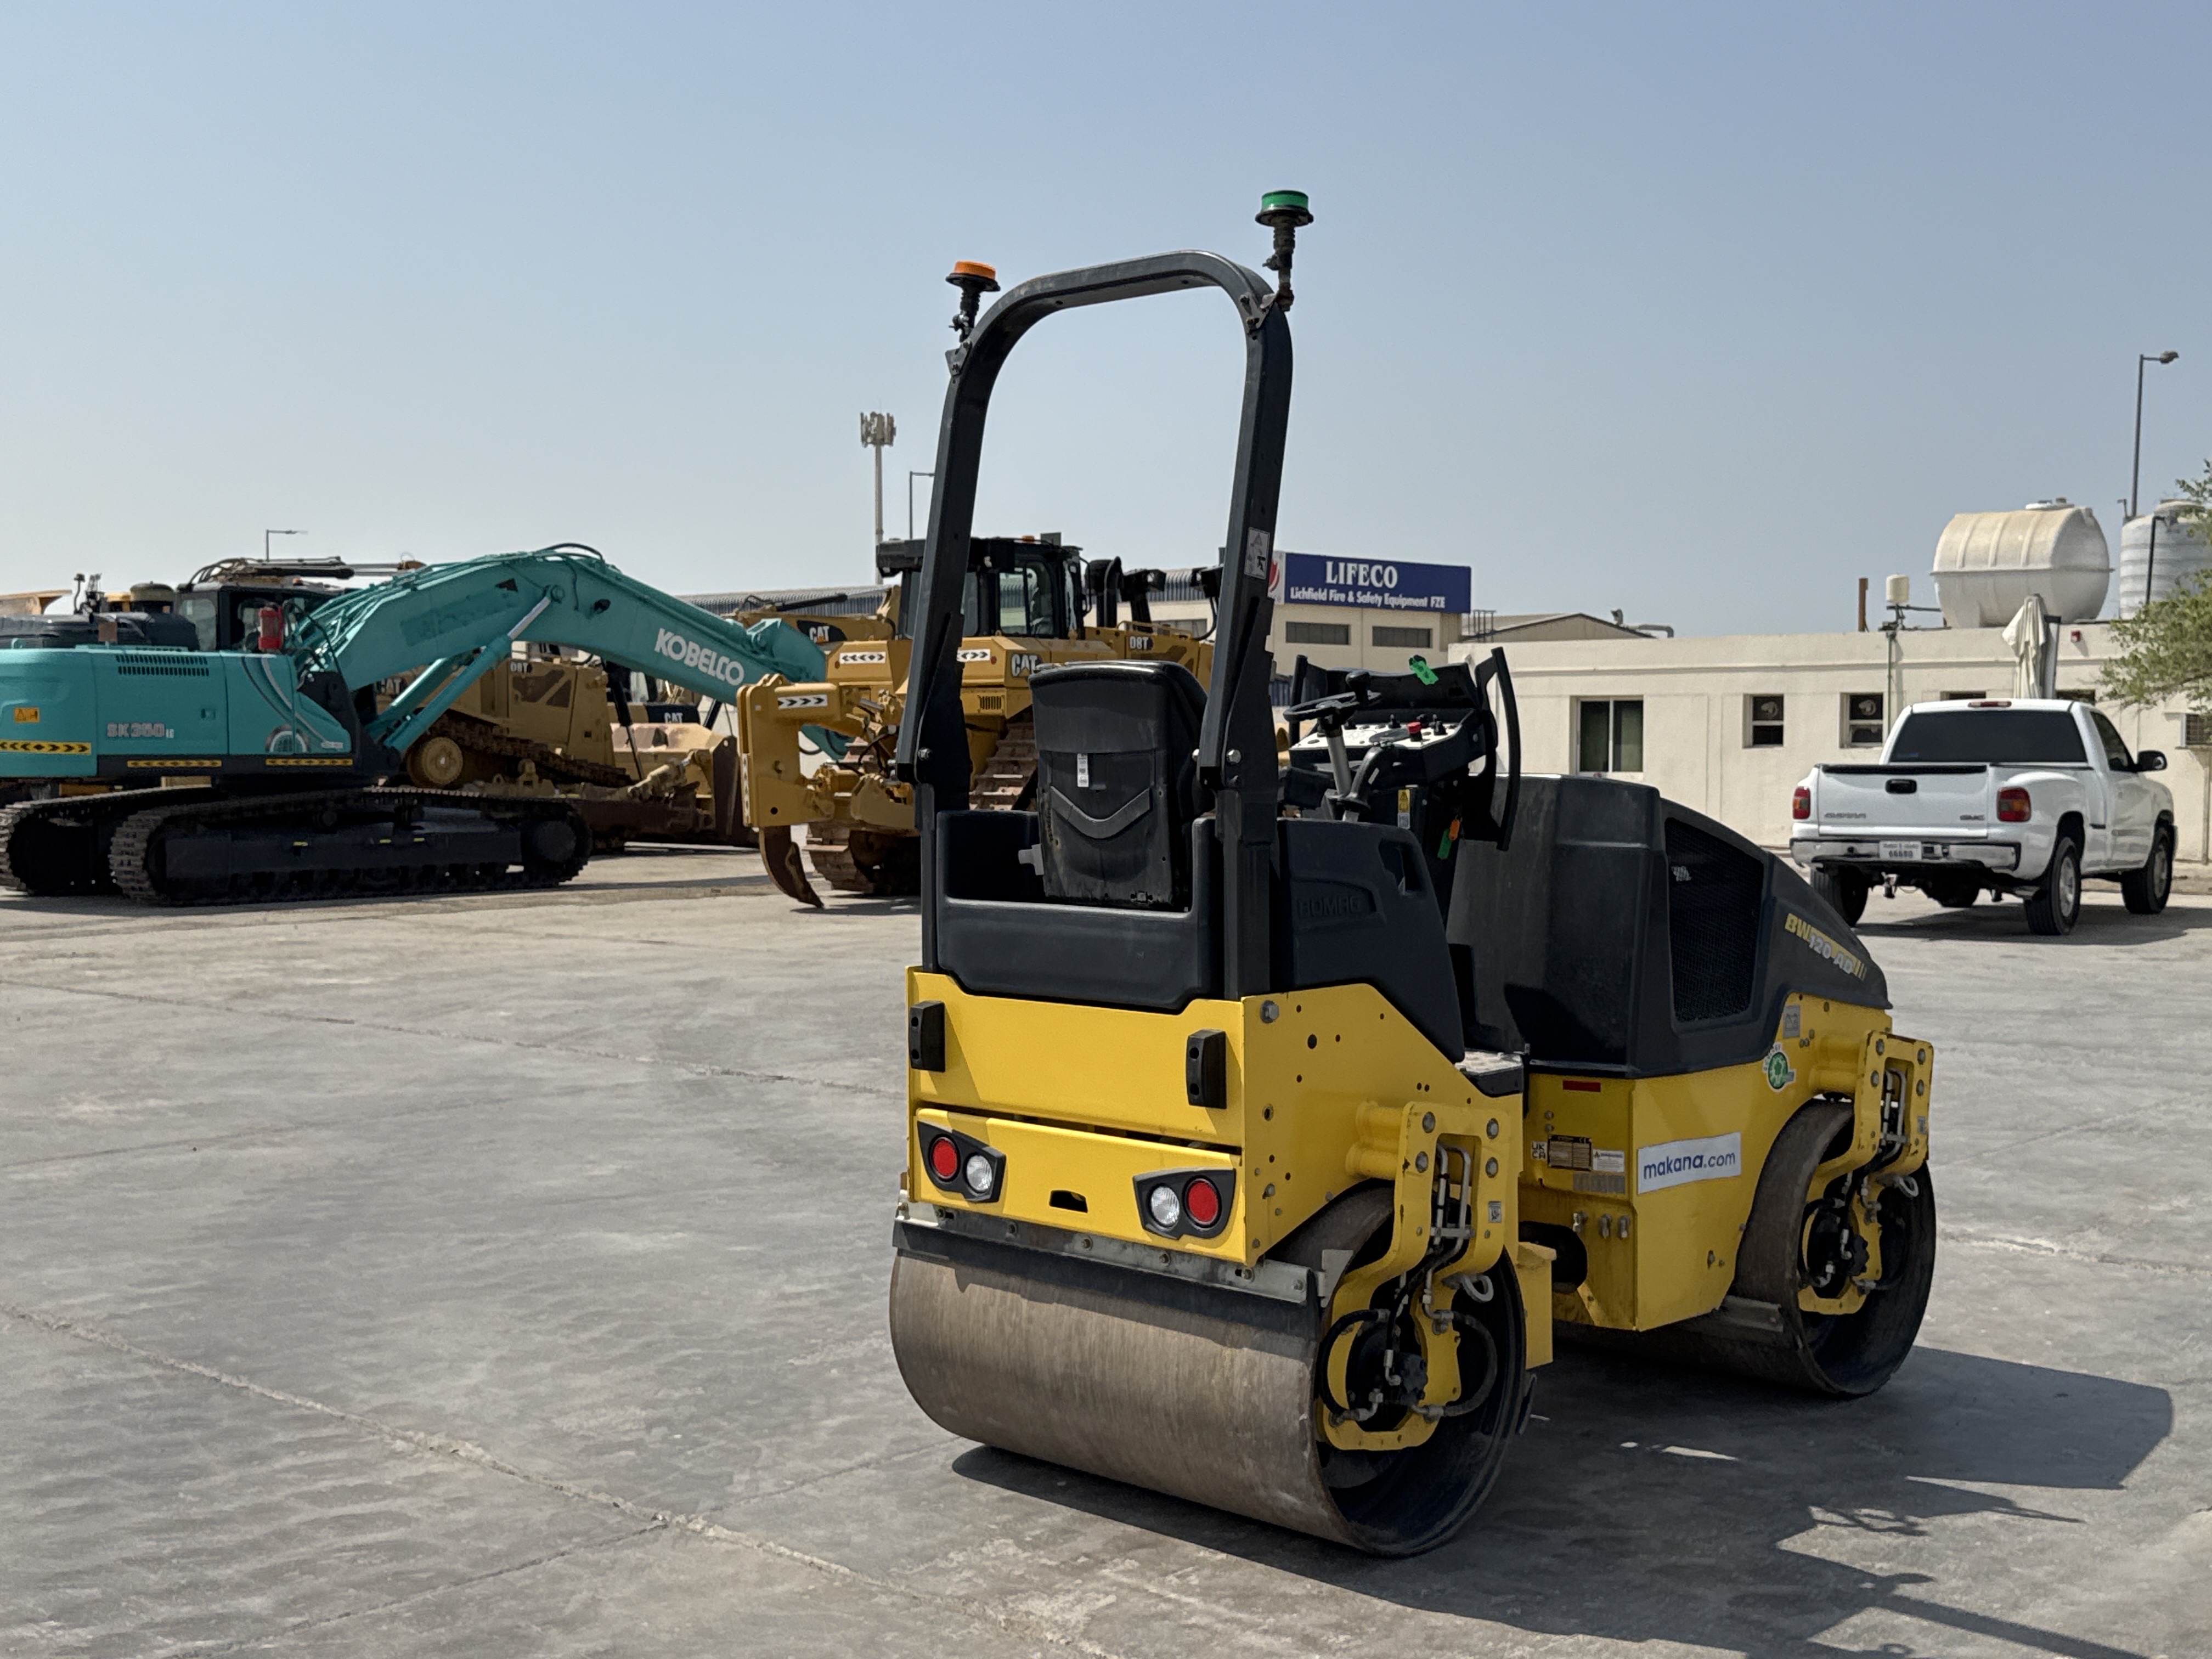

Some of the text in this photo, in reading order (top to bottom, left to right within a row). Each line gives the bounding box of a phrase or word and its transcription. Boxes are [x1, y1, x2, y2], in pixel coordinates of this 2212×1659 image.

[1325, 561, 1398, 589] LIFECO
[1290, 586, 1327, 601] Lichfield
[1329, 589, 1346, 602] Fire
[1347, 591, 1355, 603] &
[1356, 590, 1383, 607] Safety
[1384, 592, 1428, 609] Equipment
[1430, 596, 1446, 609] FZE
[809, 625, 830, 644] CAT
[654, 628, 744, 685] KOBELCO
[1011, 653, 1037, 676] CAT
[374, 677, 402, 695] CAT
[664, 712, 683, 724] CAT
[1785, 913, 1854, 975] BW 120 AD
[1643, 1152, 1736, 1180] makana.com
